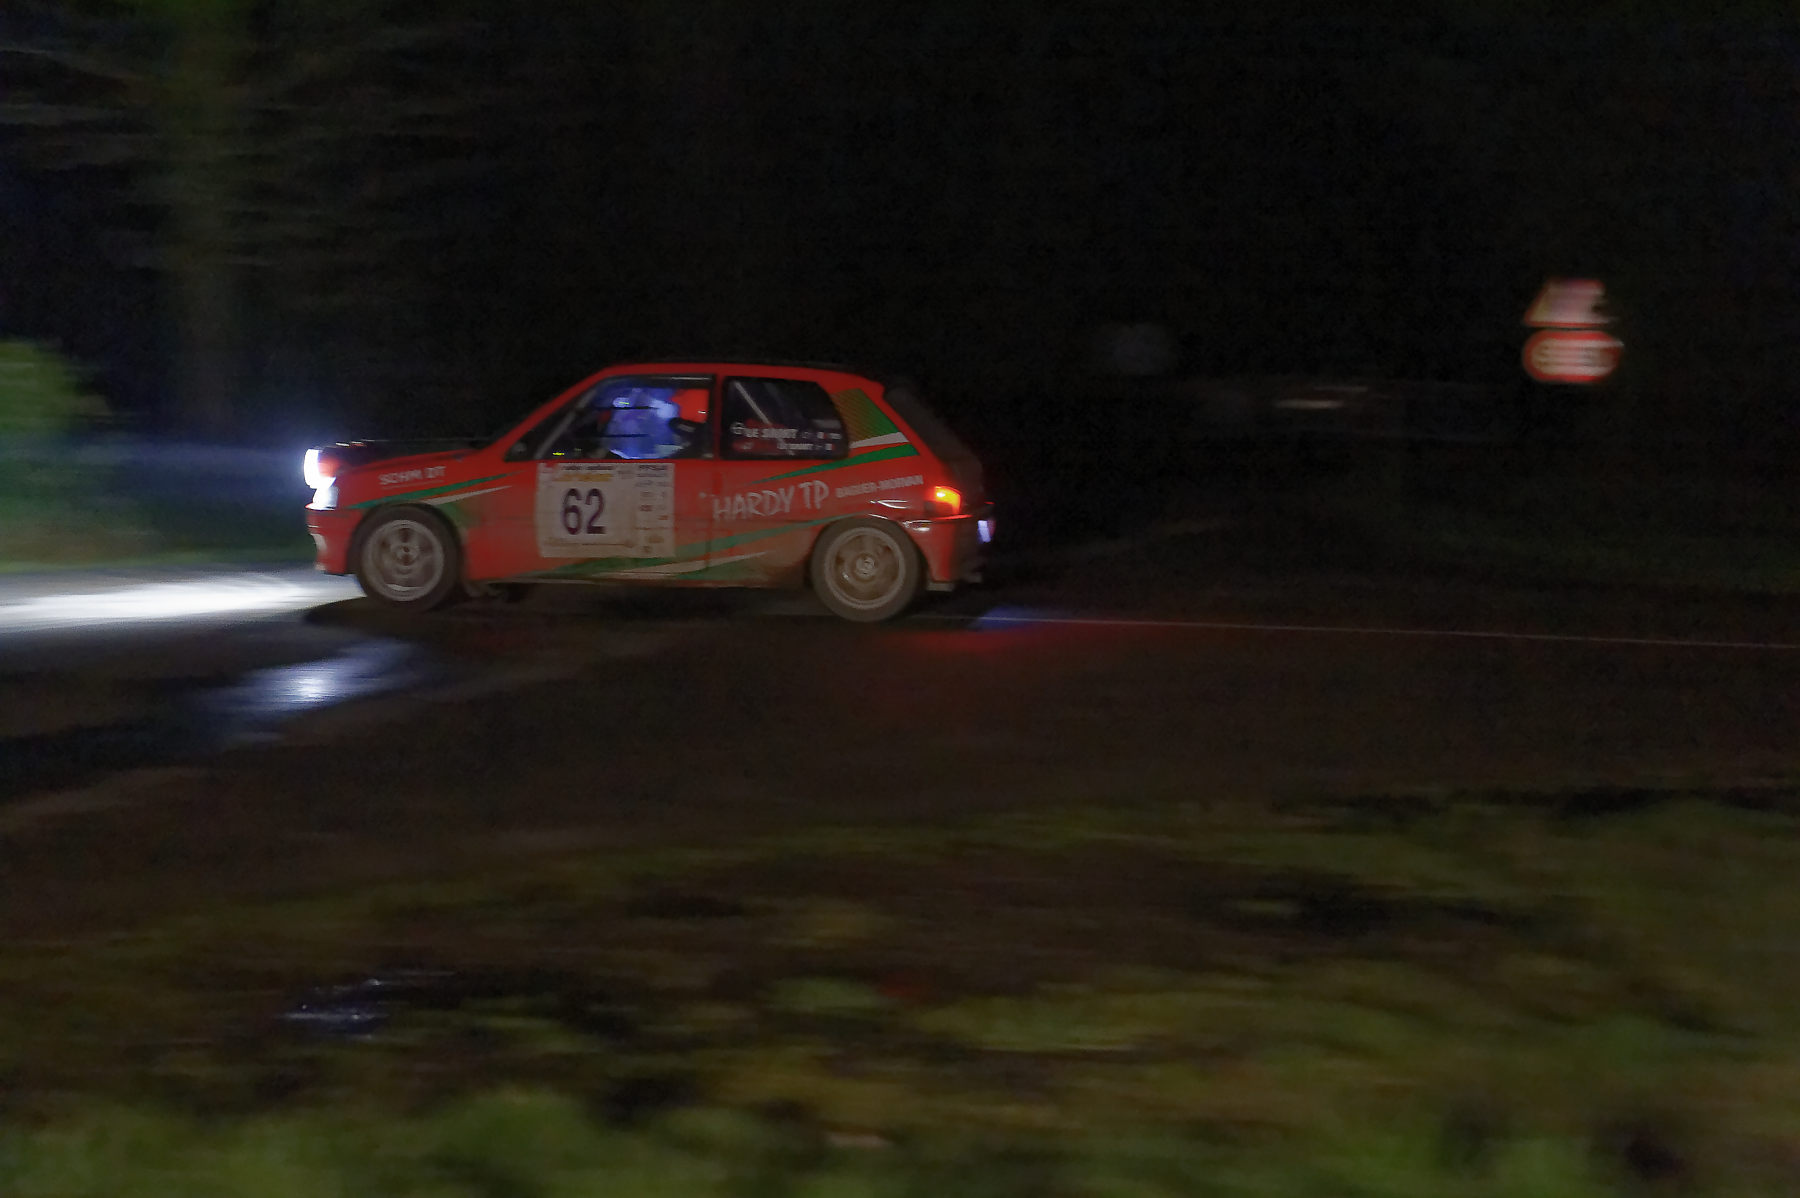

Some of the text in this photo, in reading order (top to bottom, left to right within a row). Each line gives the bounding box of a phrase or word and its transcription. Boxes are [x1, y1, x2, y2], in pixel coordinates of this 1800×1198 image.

[562, 488, 606, 535] 62
[712, 485, 795, 521] HARDY
[798, 479, 830, 510] TP
